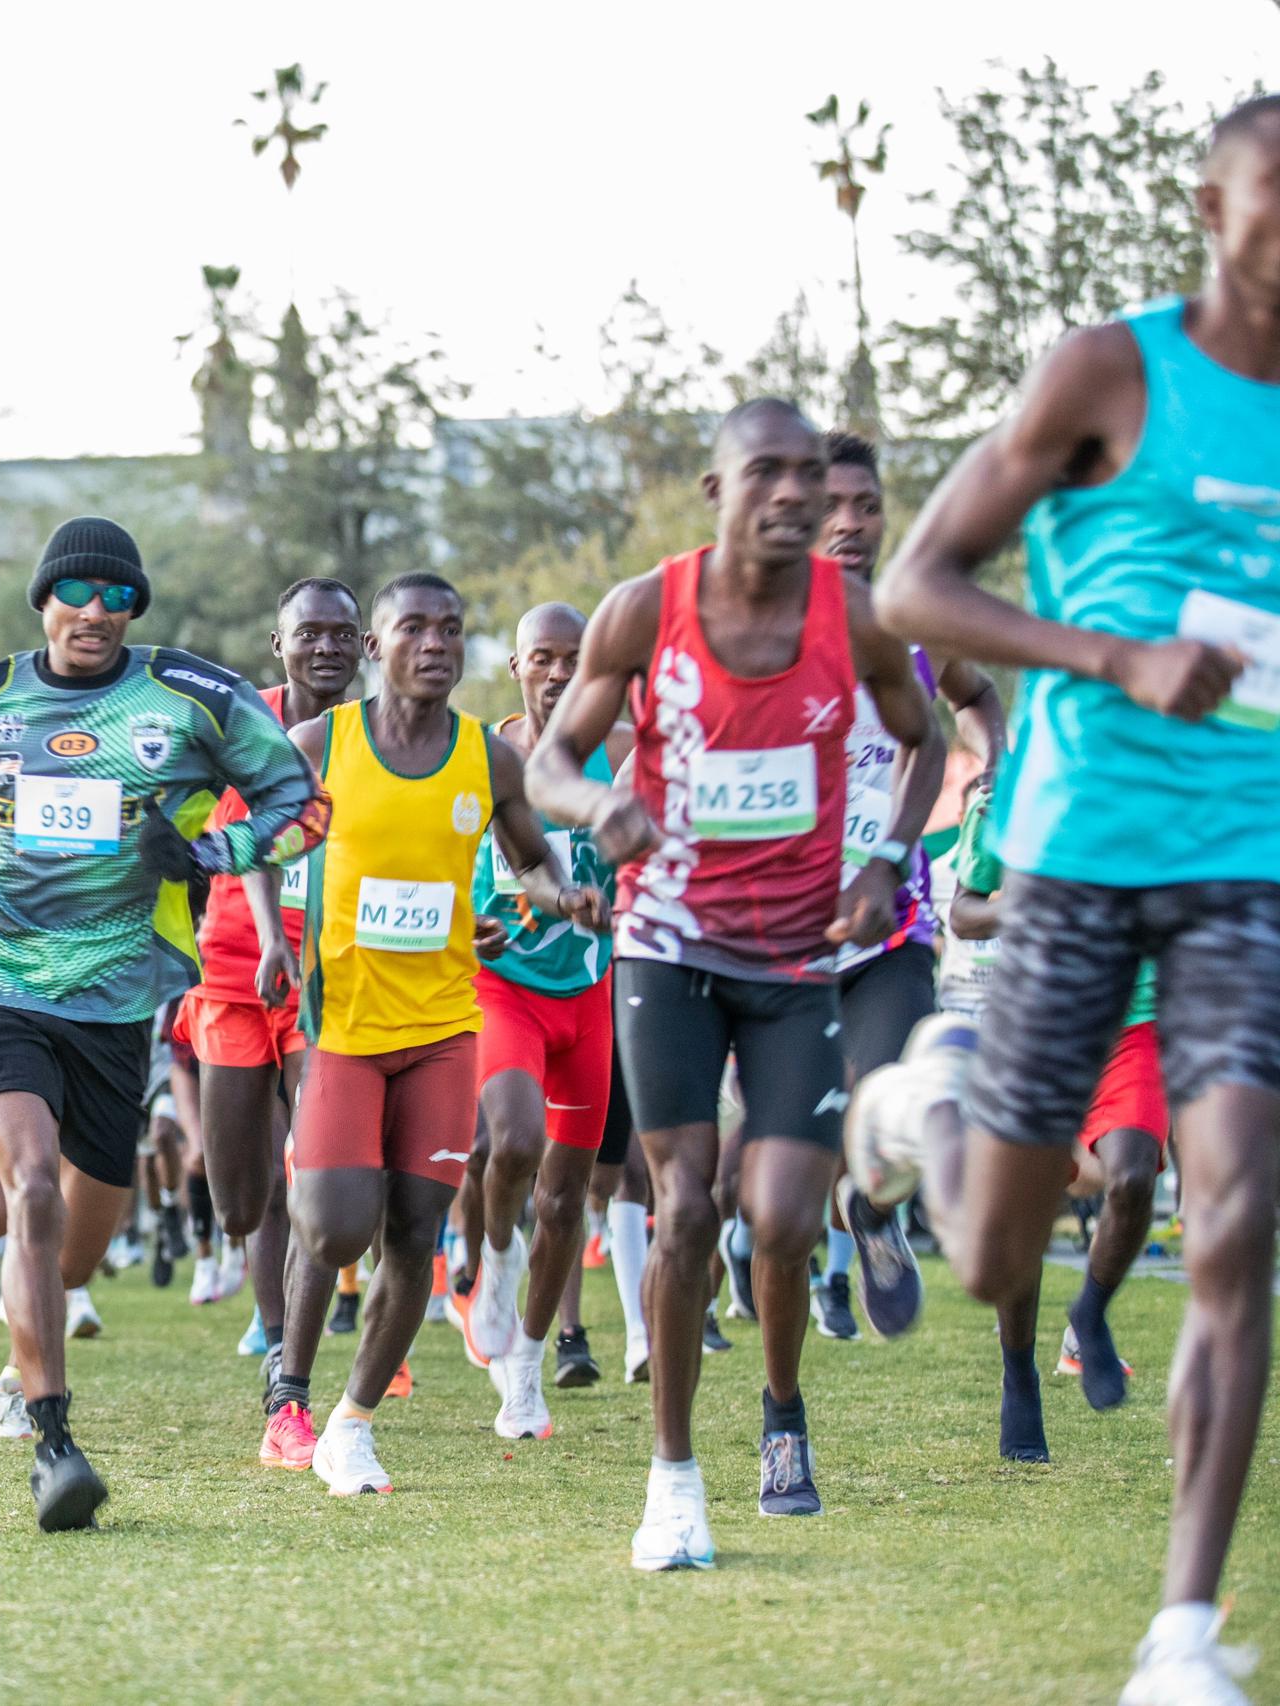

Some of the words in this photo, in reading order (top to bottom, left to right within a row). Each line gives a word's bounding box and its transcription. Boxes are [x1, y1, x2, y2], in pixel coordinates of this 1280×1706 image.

[695, 783, 729, 811] M
[737, 779, 799, 811] 258
[40, 804, 91, 831] 939
[846, 814, 880, 844] 16
[282, 869, 300, 889] M
[361, 902, 388, 925] M
[393, 906, 440, 930] 259
